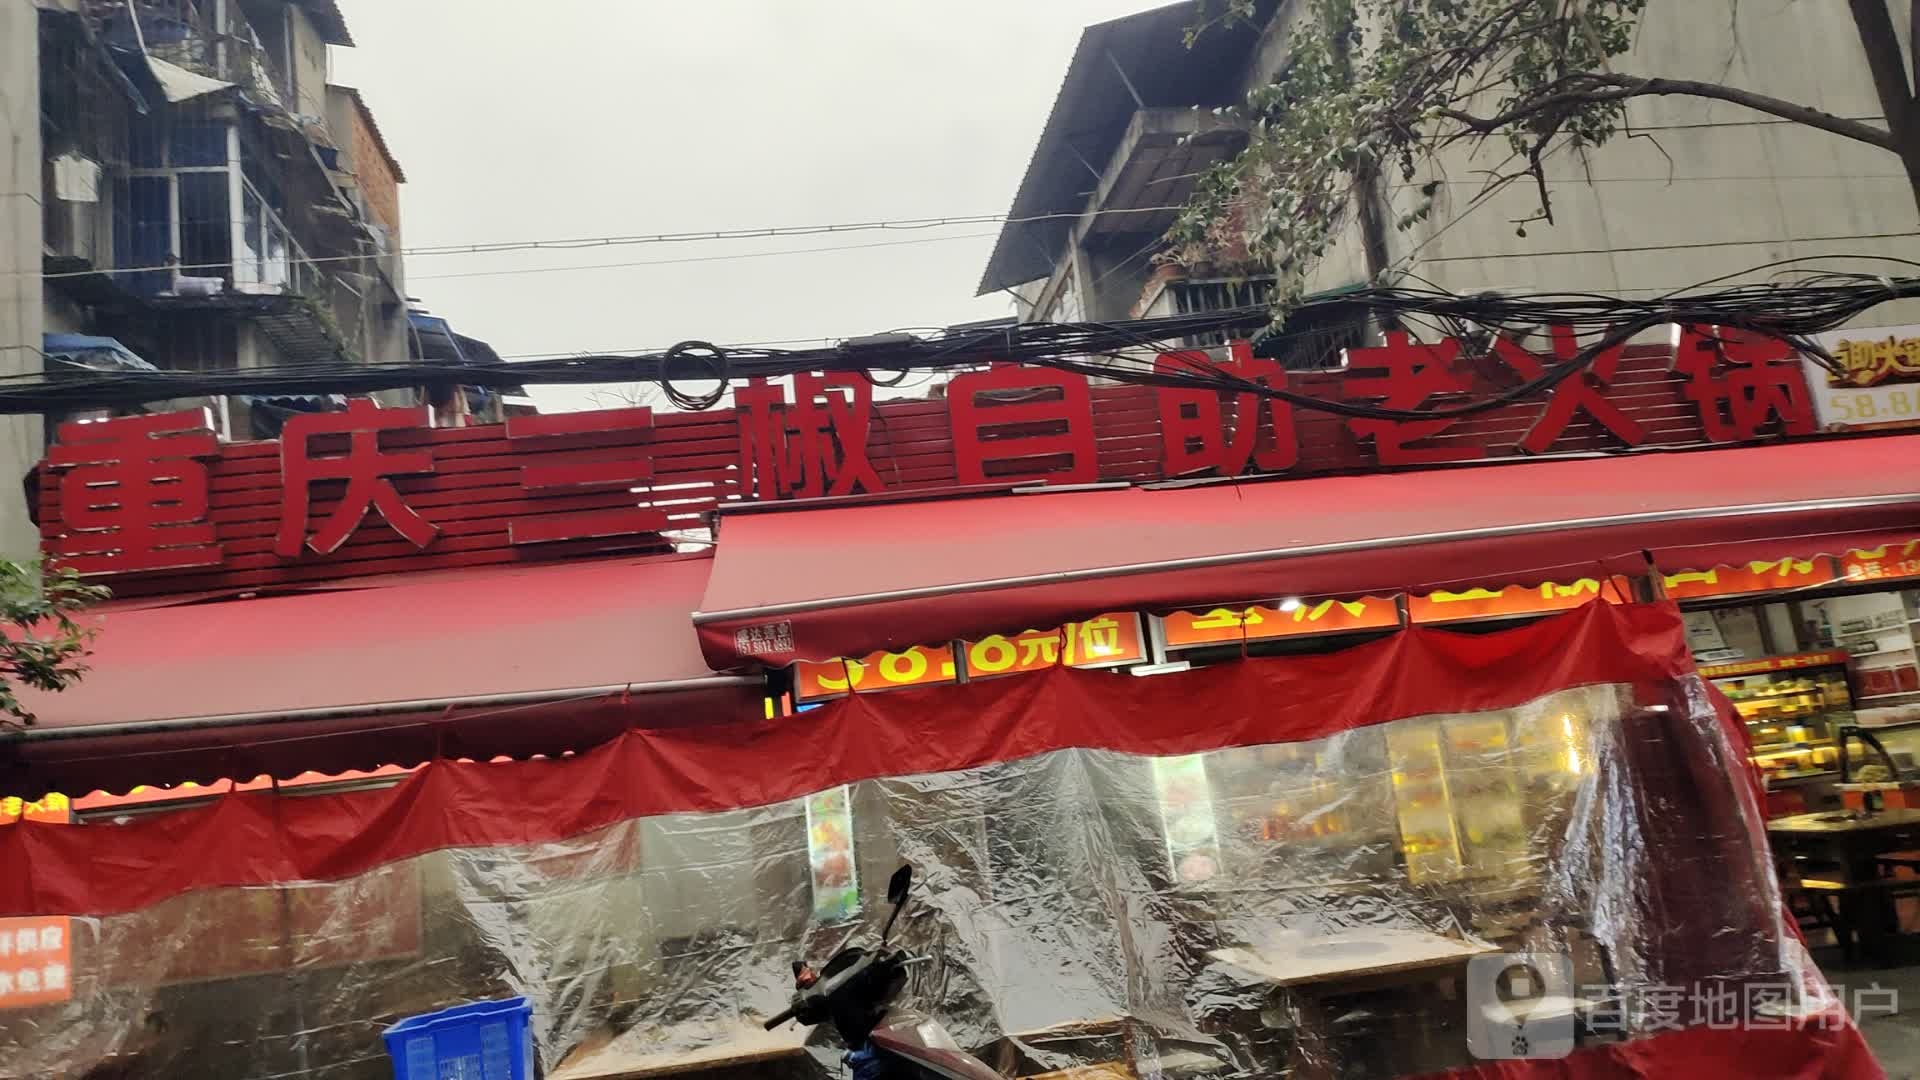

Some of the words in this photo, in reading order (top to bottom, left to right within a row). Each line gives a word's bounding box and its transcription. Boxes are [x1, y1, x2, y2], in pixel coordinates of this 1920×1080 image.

[44, 321, 1819, 576] 重庆三椒自助老火锅
